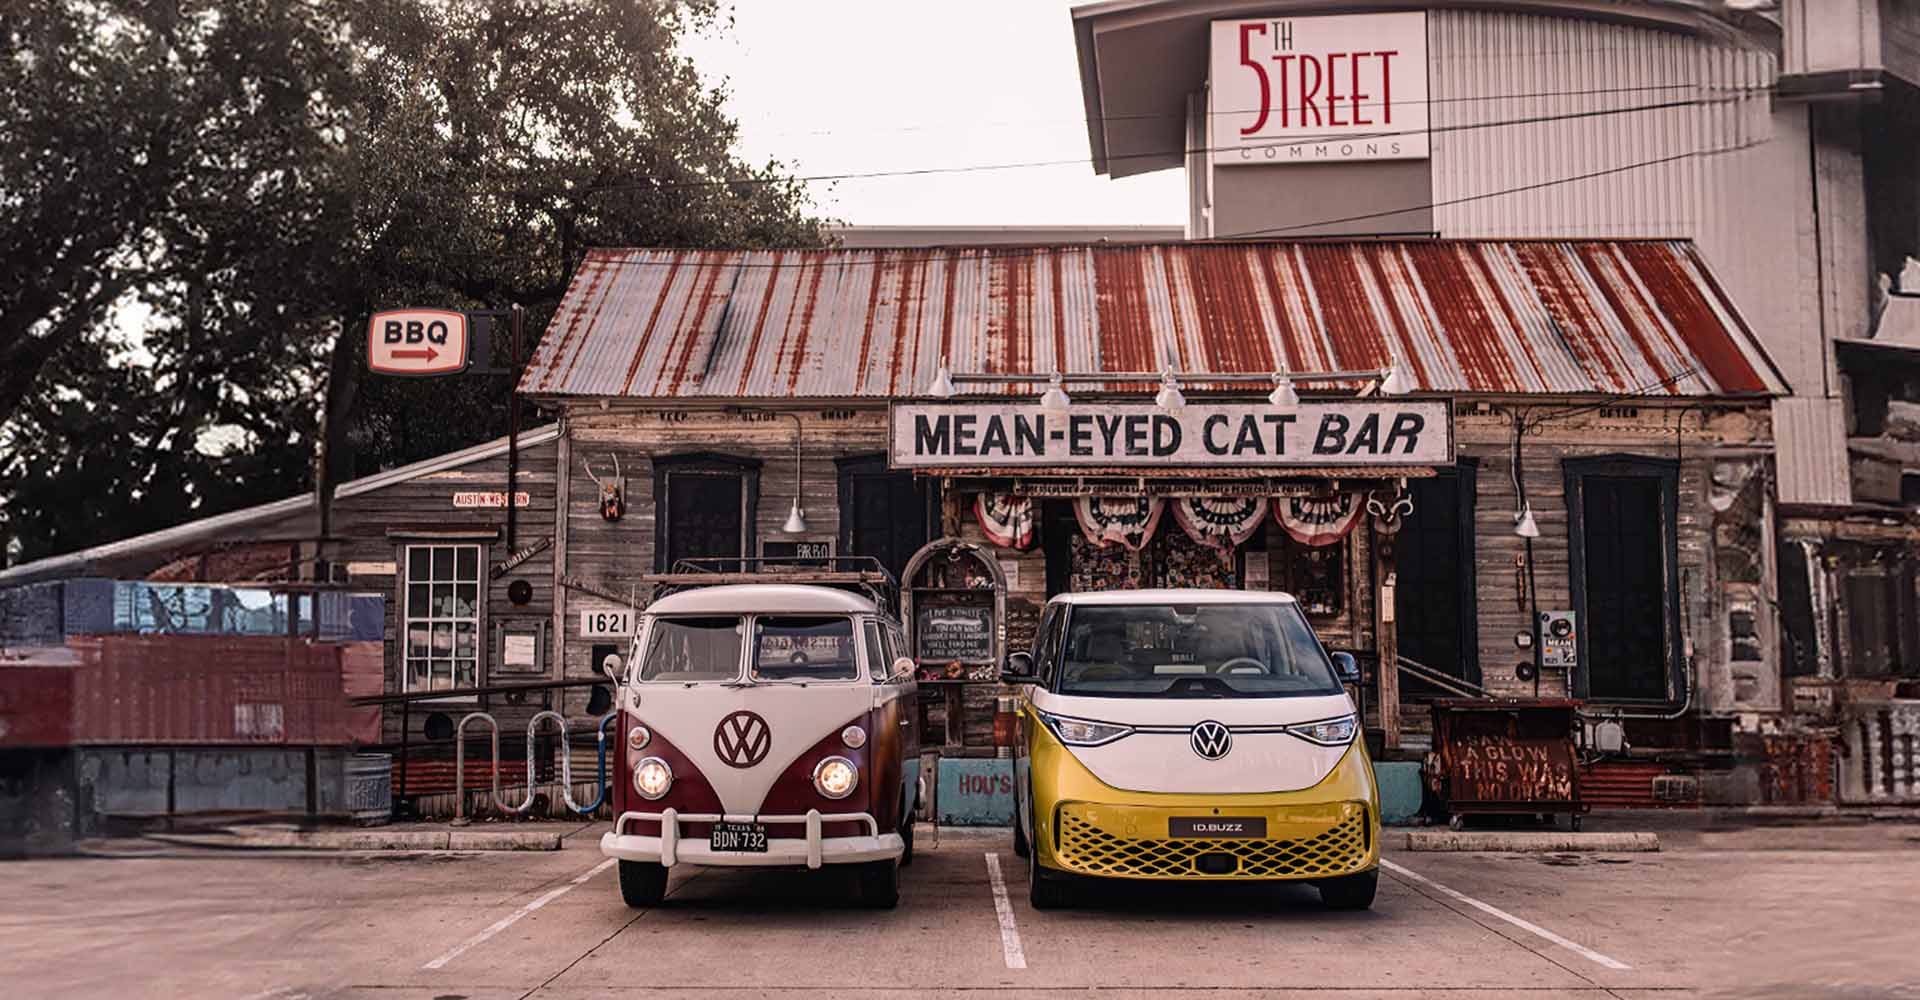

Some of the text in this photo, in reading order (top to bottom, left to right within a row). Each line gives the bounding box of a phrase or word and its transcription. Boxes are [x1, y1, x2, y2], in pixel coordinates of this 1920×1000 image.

[1240, 142, 1400, 159] COMMONS
[384, 320, 448, 345] BBQ
[914, 412, 1425, 457] MEAN-EYED CAT BAR
[455, 494, 528, 505] AUSTIN-WESRN
[588, 613, 627, 633] 1621
[1460, 760, 1507, 782] THIS
[1192, 823, 1243, 832] ID.BUZZ
